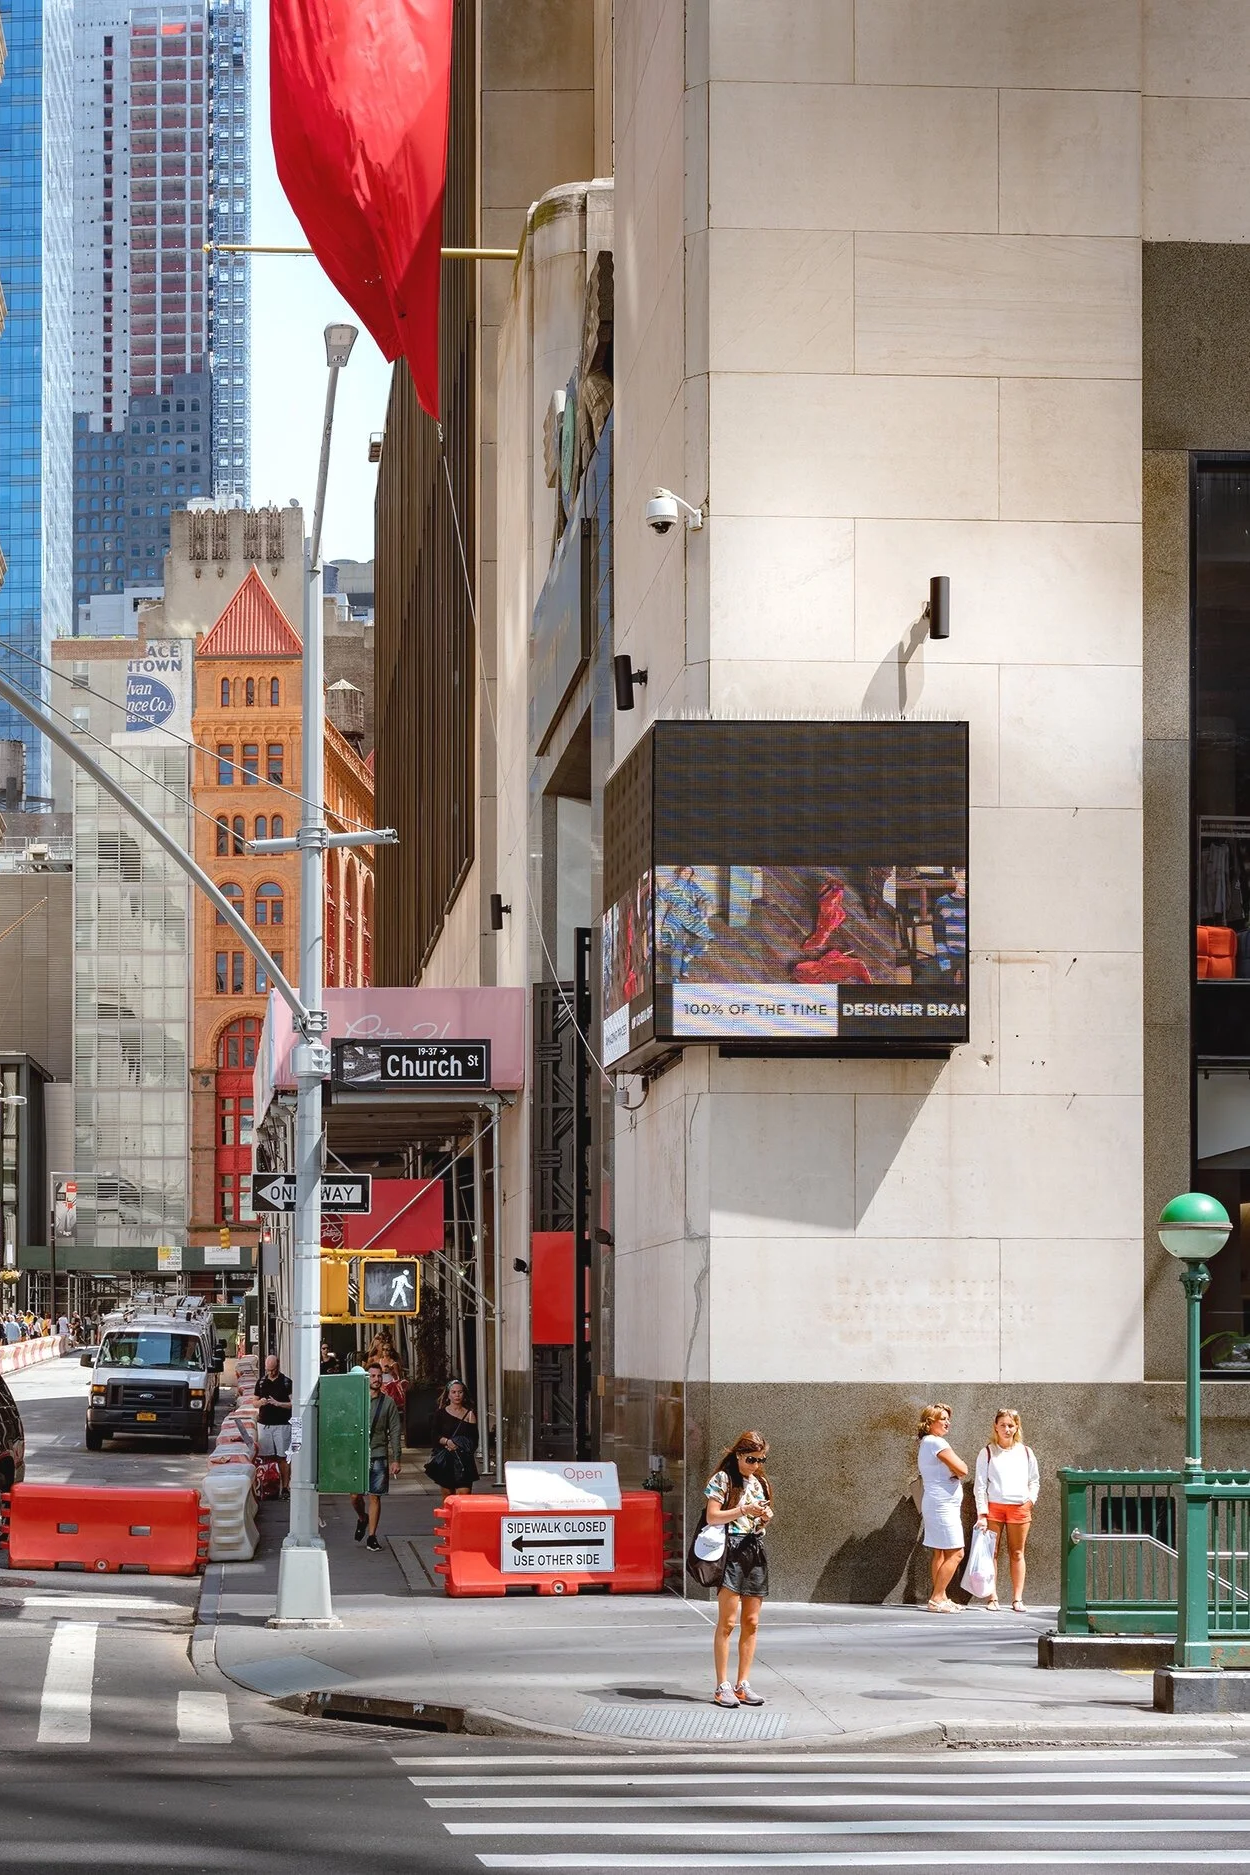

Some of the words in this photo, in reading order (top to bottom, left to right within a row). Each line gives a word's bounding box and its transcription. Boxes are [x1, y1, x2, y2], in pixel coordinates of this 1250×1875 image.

[148, 645, 179, 658] ACE
[684, 1004, 723, 1015] 100%
[729, 1004, 750, 1015] OF
[756, 1004, 786, 1015] THE
[792, 1004, 827, 1015] TIME
[842, 1003, 923, 1016] DESIGNER
[418, 1048, 438, 1056] 19-37
[386, 1055, 462, 1077] Church
[467, 1055, 479, 1066] St
[320, 1187, 354, 1201] WAY
[564, 1467, 602, 1481] Open
[507, 1522, 561, 1534] SIDEWALK
[564, 1521, 606, 1533] CLOSED
[513, 1555, 535, 1566] USE
[538, 1554, 573, 1566] OTHER
[576, 1553, 600, 1565] SIDE
